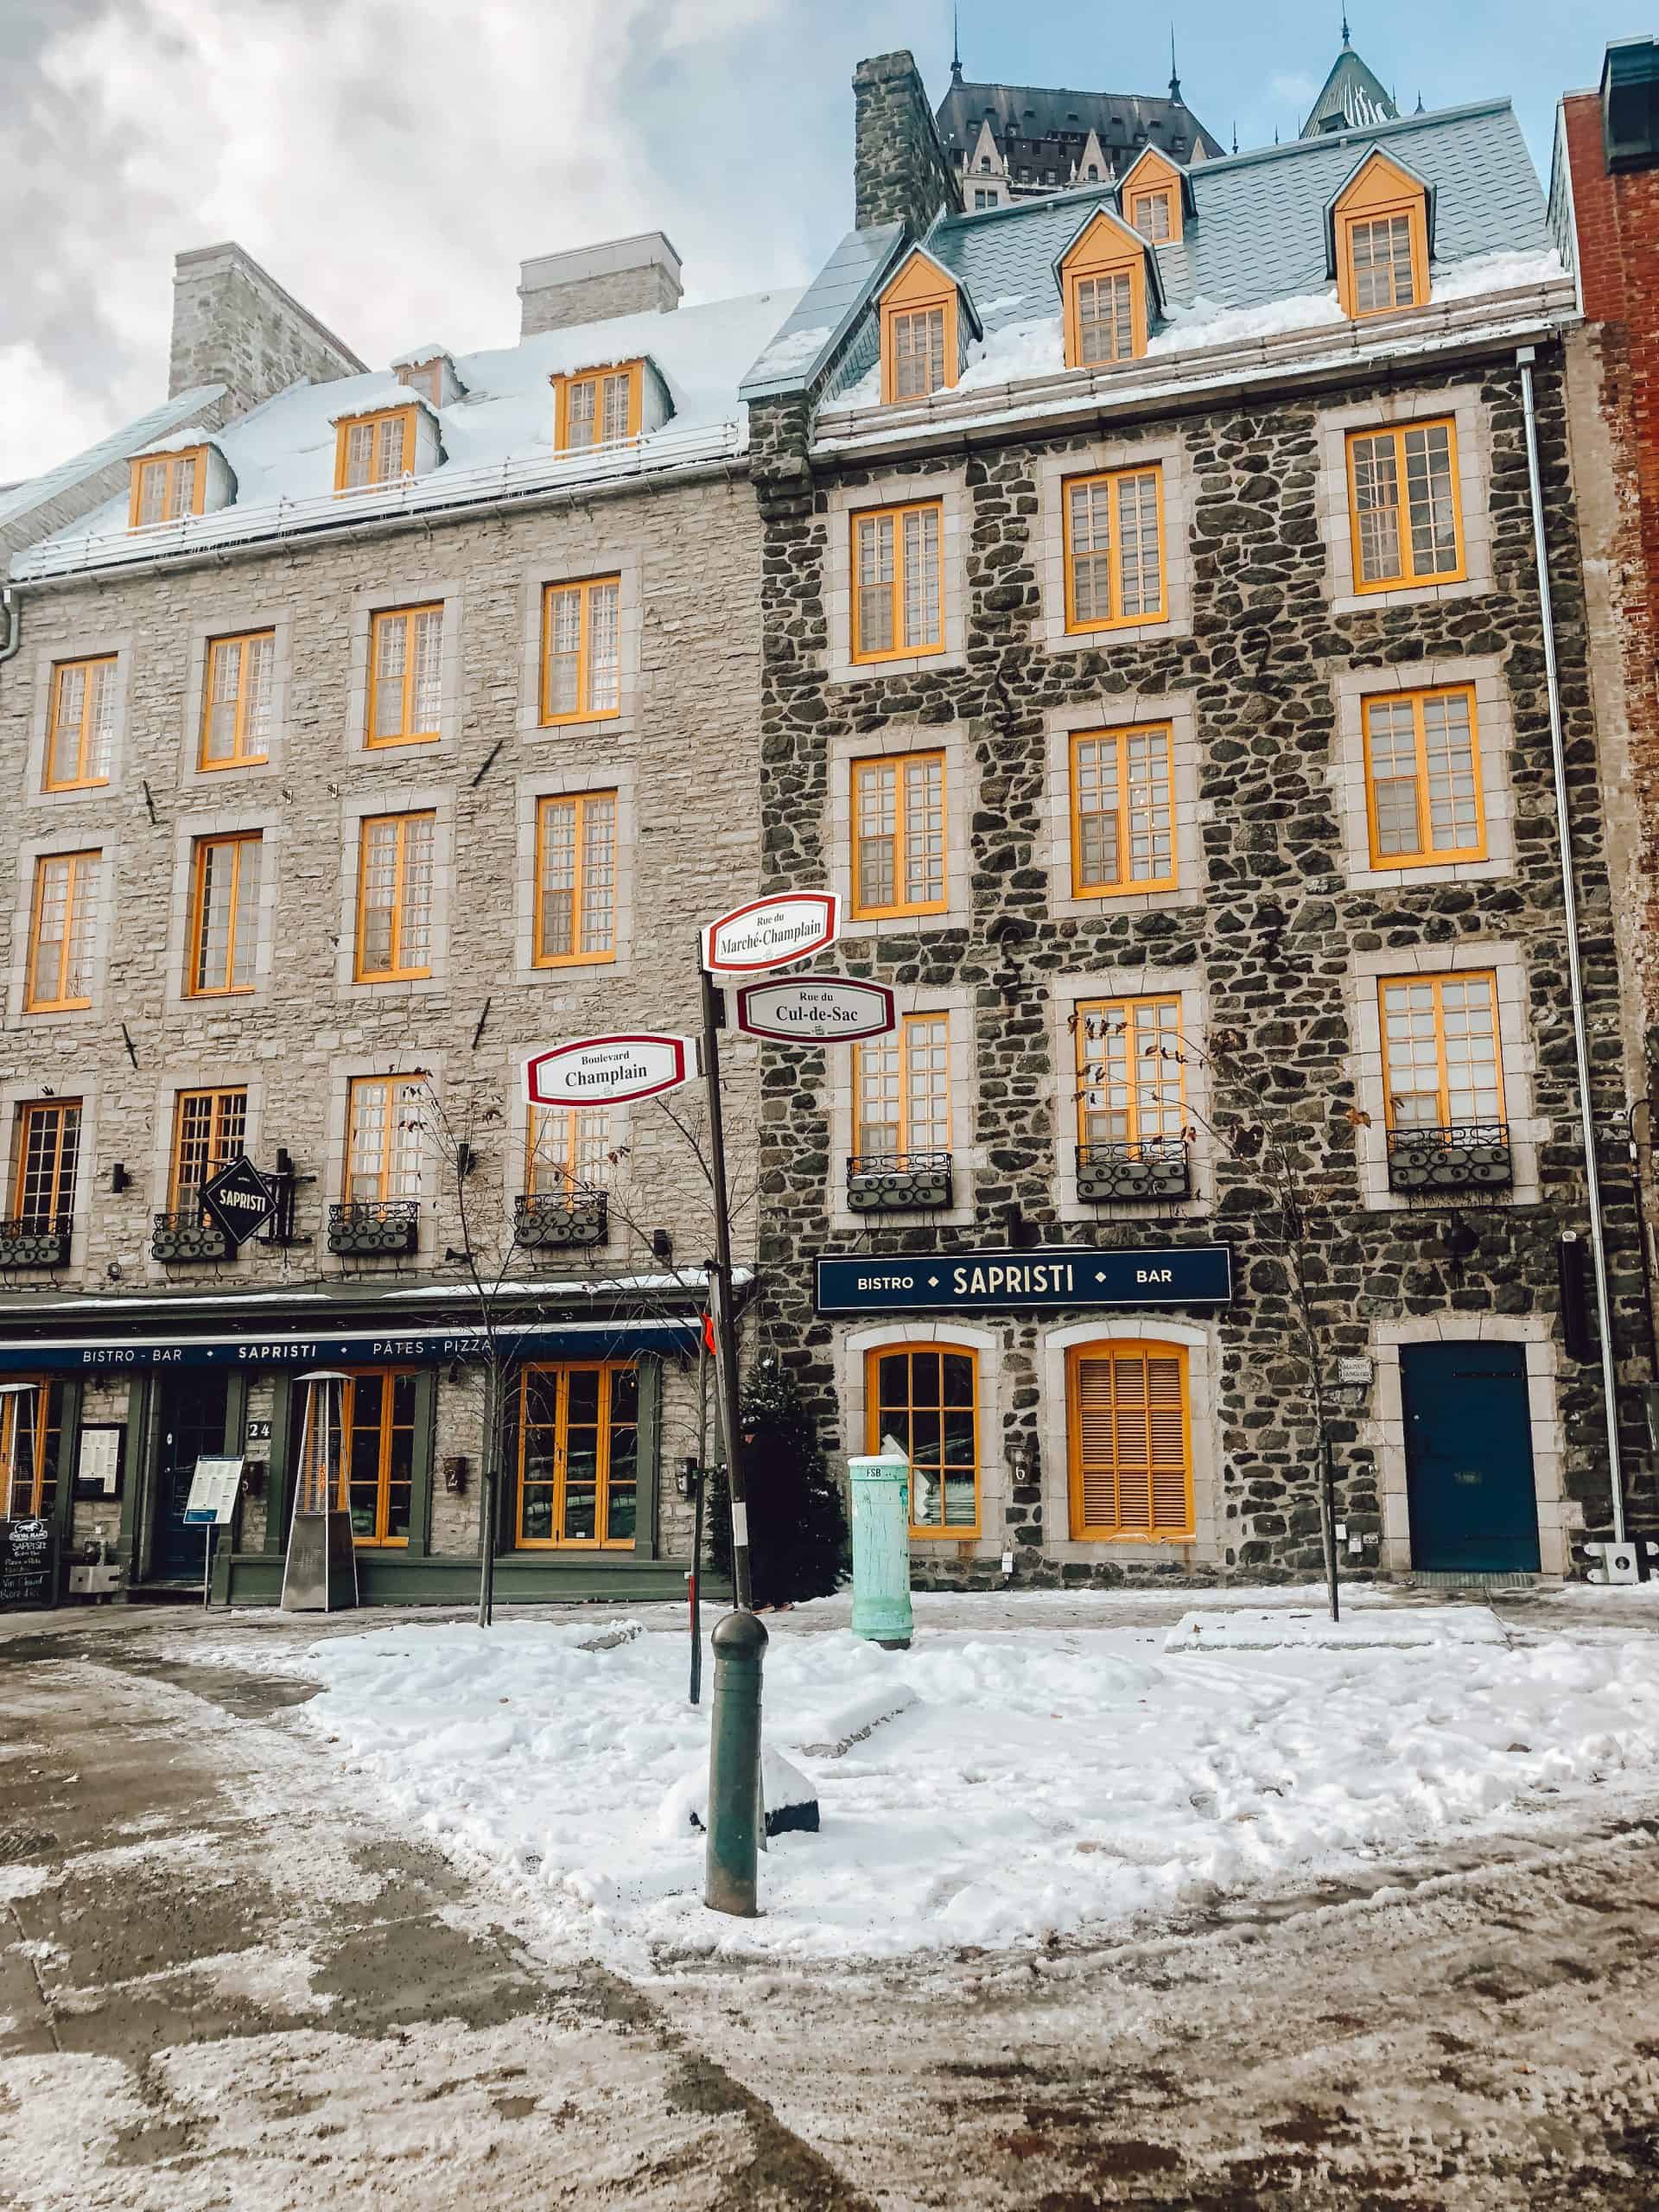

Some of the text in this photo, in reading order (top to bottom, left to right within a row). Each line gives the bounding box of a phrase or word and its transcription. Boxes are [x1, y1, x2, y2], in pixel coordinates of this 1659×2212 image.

[757, 912, 785, 926] Rue du
[720, 919, 821, 956] Marché-Champlain
[799, 992, 834, 1001] Rue du
[776, 1005, 858, 1021] Cul-de-Sac
[581, 1050, 630, 1065] Boulevard
[564, 1063, 647, 1087] Champlain
[219, 1189, 266, 1212] SAPRISTI
[857, 1264, 1173, 1294] BISTRO SAPRISTI BAR
[83, 1338, 492, 1363] BISTRO BAR SAPRISTI PÂTES PIZZA
[249, 1423, 270, 1437] 24
[448, 1469, 458, 1487] 2
[1015, 1465, 1026, 1479] 6
